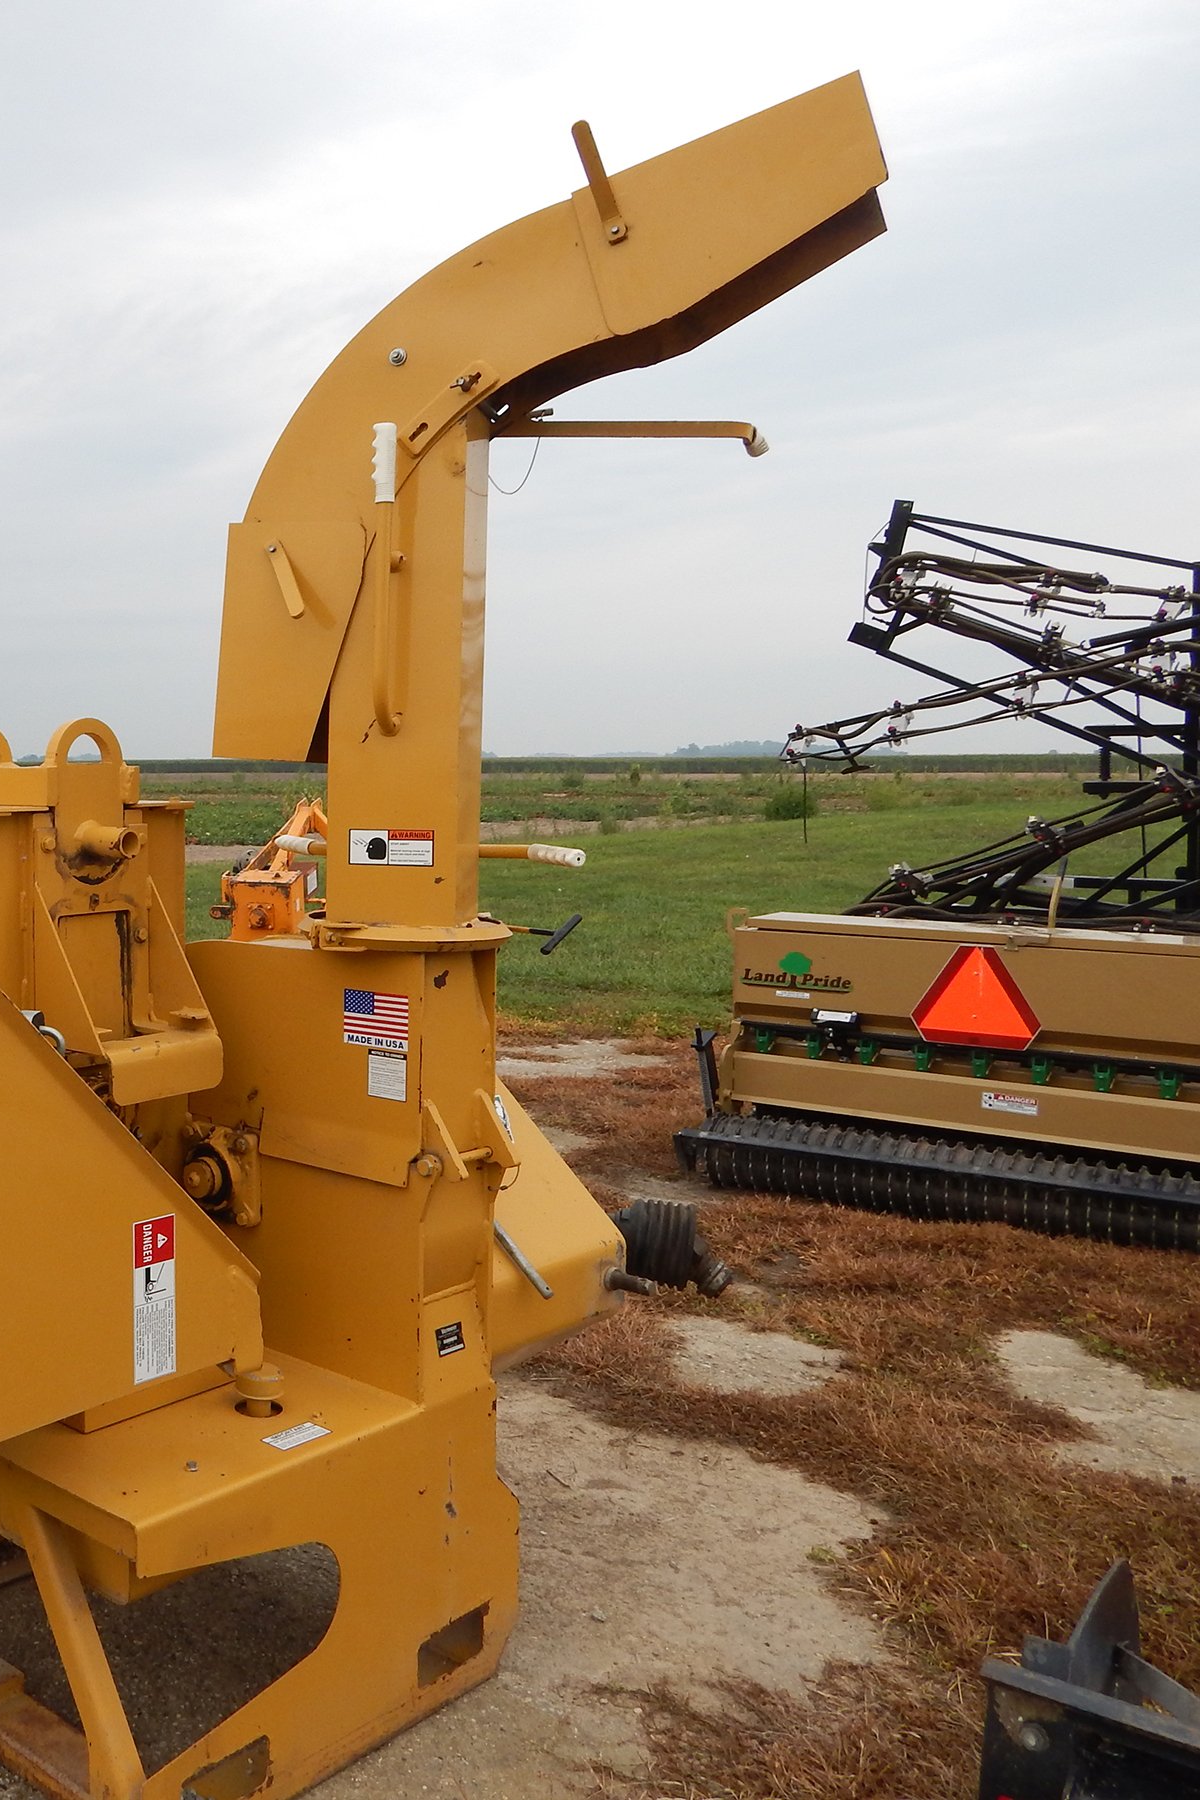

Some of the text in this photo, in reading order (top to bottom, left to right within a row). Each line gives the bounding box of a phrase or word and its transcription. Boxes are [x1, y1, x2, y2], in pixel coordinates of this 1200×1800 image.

[398, 831, 431, 839] WARNING
[743, 968, 852, 989] Land Pride
[347, 1034, 405, 1049] MADE IN USA
[1004, 1095, 1036, 1104] DANGER
[143, 1223, 153, 1263] DANGER
